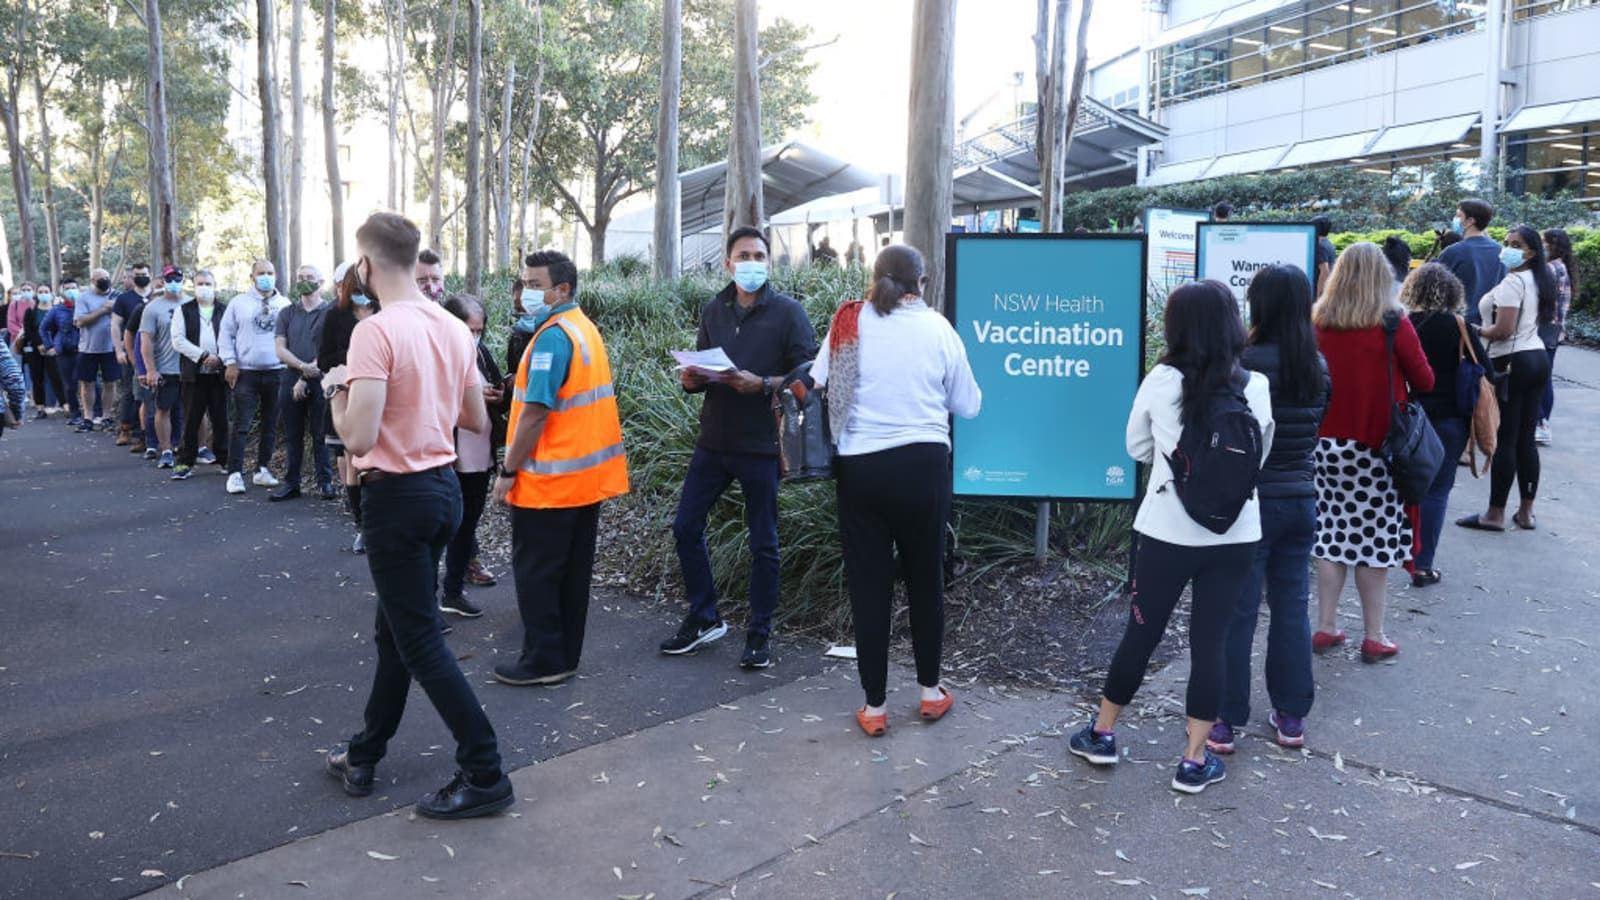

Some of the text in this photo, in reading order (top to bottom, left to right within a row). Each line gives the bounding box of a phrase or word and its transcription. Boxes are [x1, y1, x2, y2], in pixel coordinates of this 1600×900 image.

[994, 293, 1104, 313] NSW Health
[972, 320, 1123, 346] Vaccination
[1004, 352, 1090, 377] Centre
